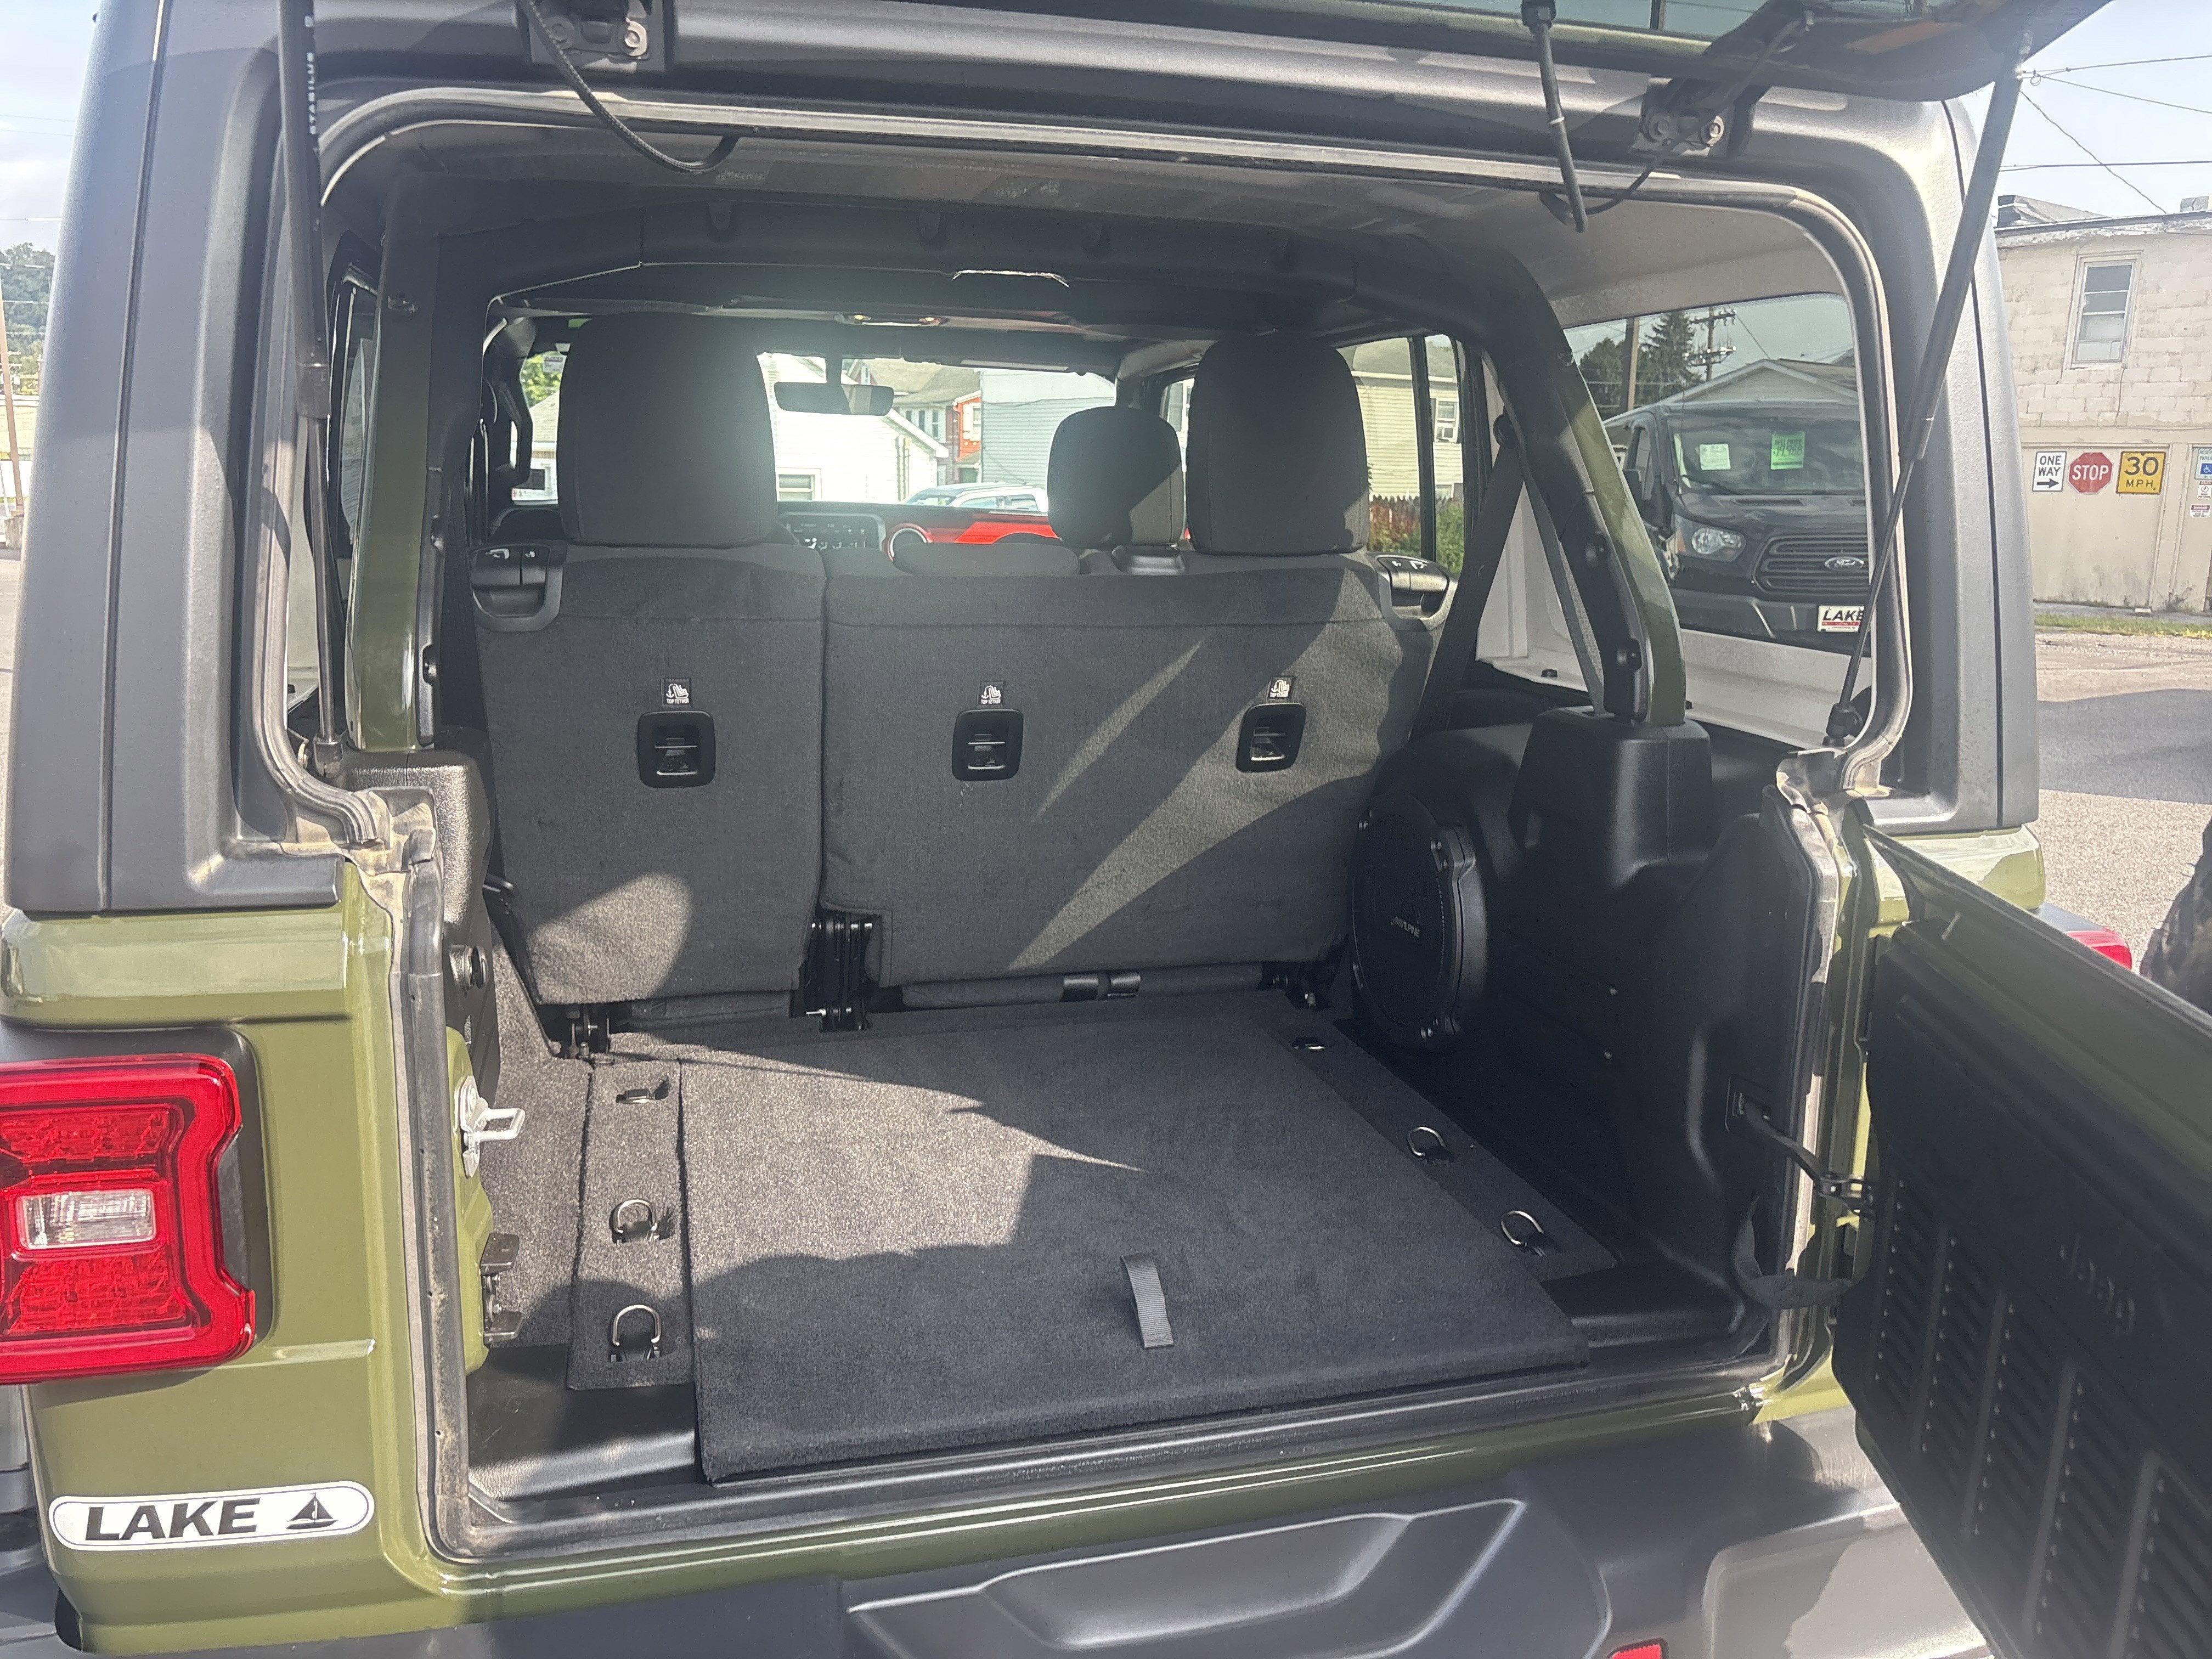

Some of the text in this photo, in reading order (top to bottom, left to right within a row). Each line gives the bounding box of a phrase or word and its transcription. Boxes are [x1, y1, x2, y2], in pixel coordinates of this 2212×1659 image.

[2040, 455, 2062, 465] ONE
[2124, 456, 2159, 476] 30
[2039, 467, 2061, 476] WAY
[2072, 465, 2109, 481] STOP
[2126, 479, 2153, 488] MPH
[85, 1498, 261, 1541] LAKE
